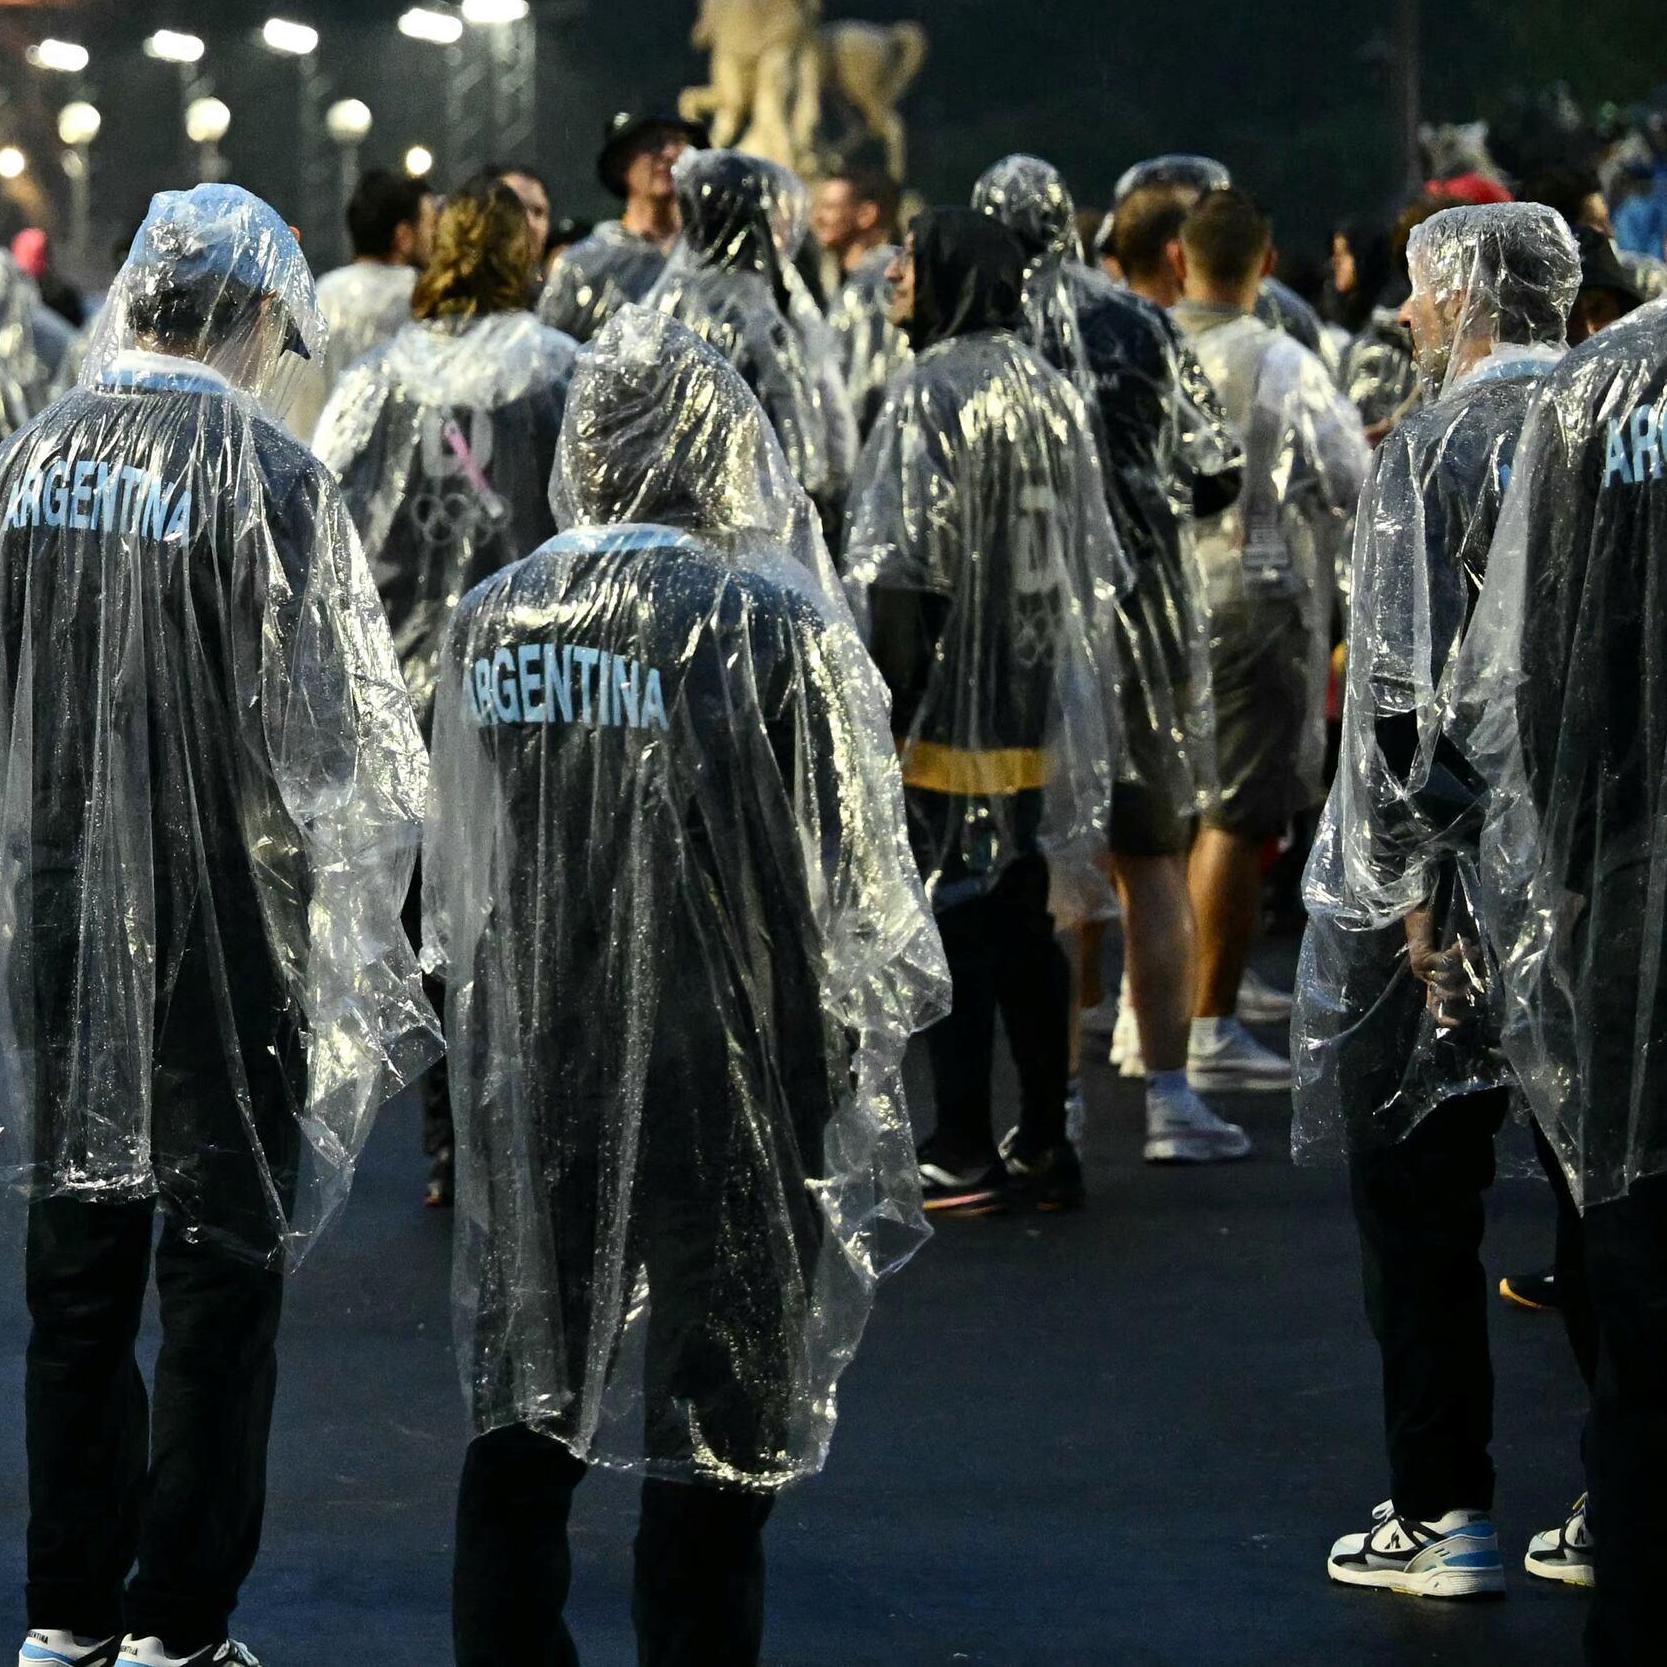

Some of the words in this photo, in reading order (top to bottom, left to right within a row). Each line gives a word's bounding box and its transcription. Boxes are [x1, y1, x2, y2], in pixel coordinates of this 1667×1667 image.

[1604, 403, 1667, 488] AR
[5, 460, 193, 544] ARGENTINA
[464, 642, 669, 731] ARGENTINA
